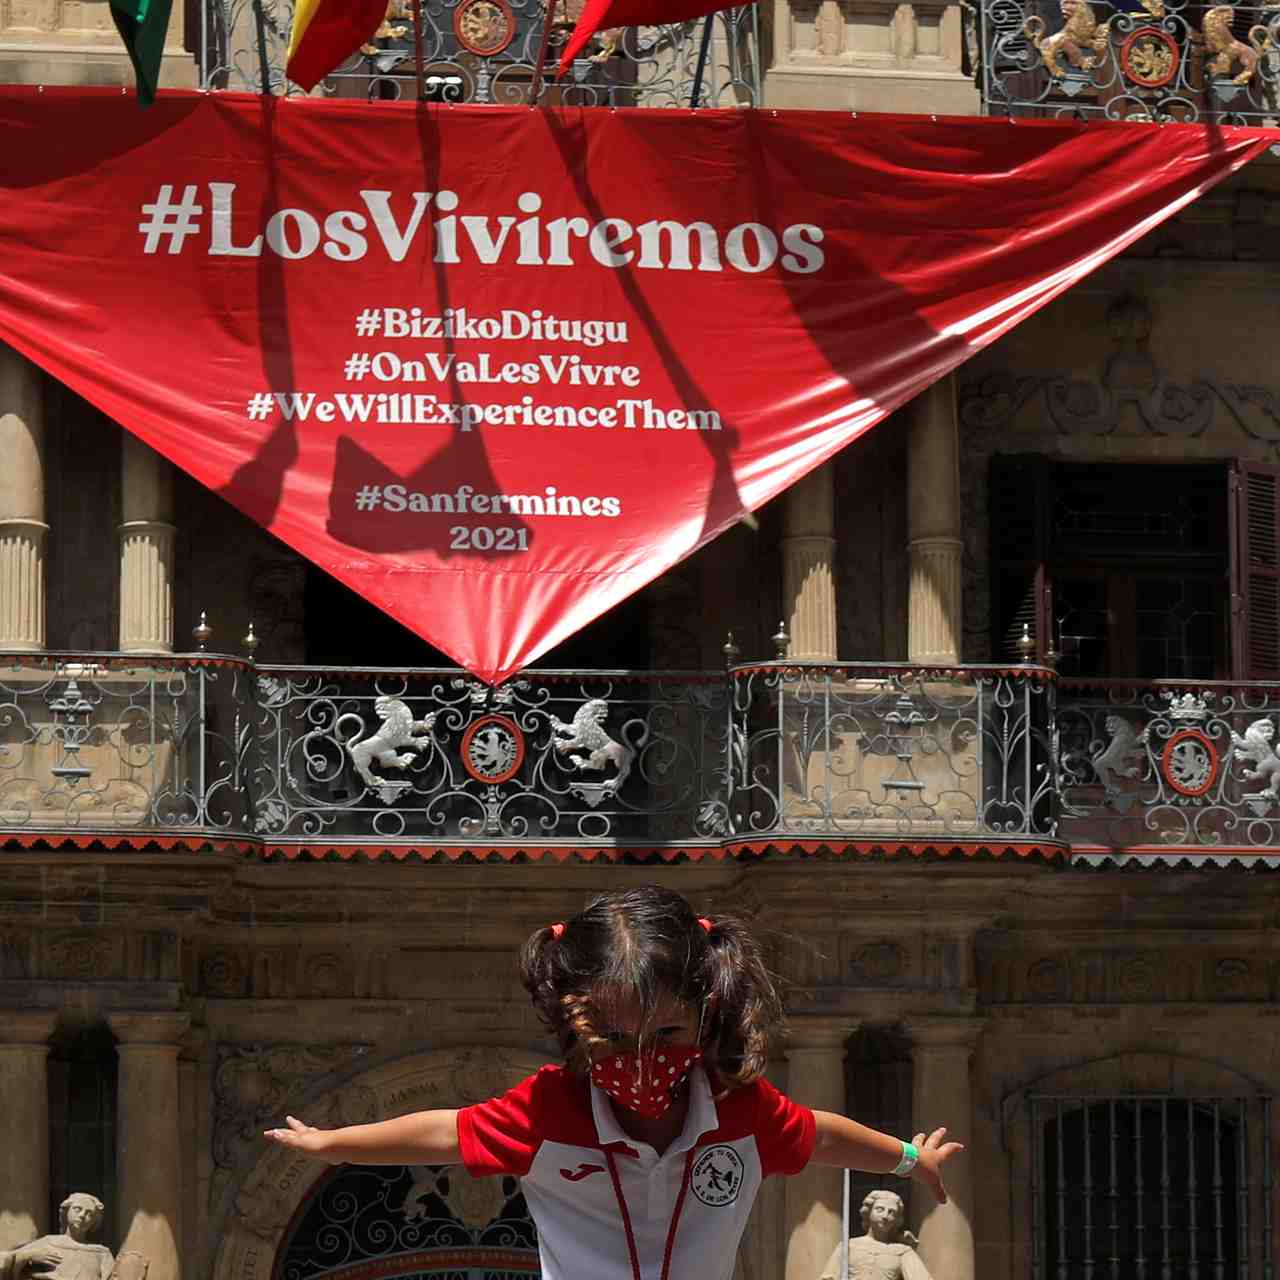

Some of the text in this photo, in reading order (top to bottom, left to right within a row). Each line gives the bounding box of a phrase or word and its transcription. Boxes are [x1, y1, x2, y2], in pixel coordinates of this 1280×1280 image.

[138, 181, 826, 274] #LosViviremos
[355, 307, 628, 345] #BizikoDitugu
[344, 351, 640, 387] #OnVaLesVivre
[247, 391, 722, 432] #WeWillExperienceThem
[355, 485, 621, 517] #Sanfermines
[449, 525, 529, 552] 2021
